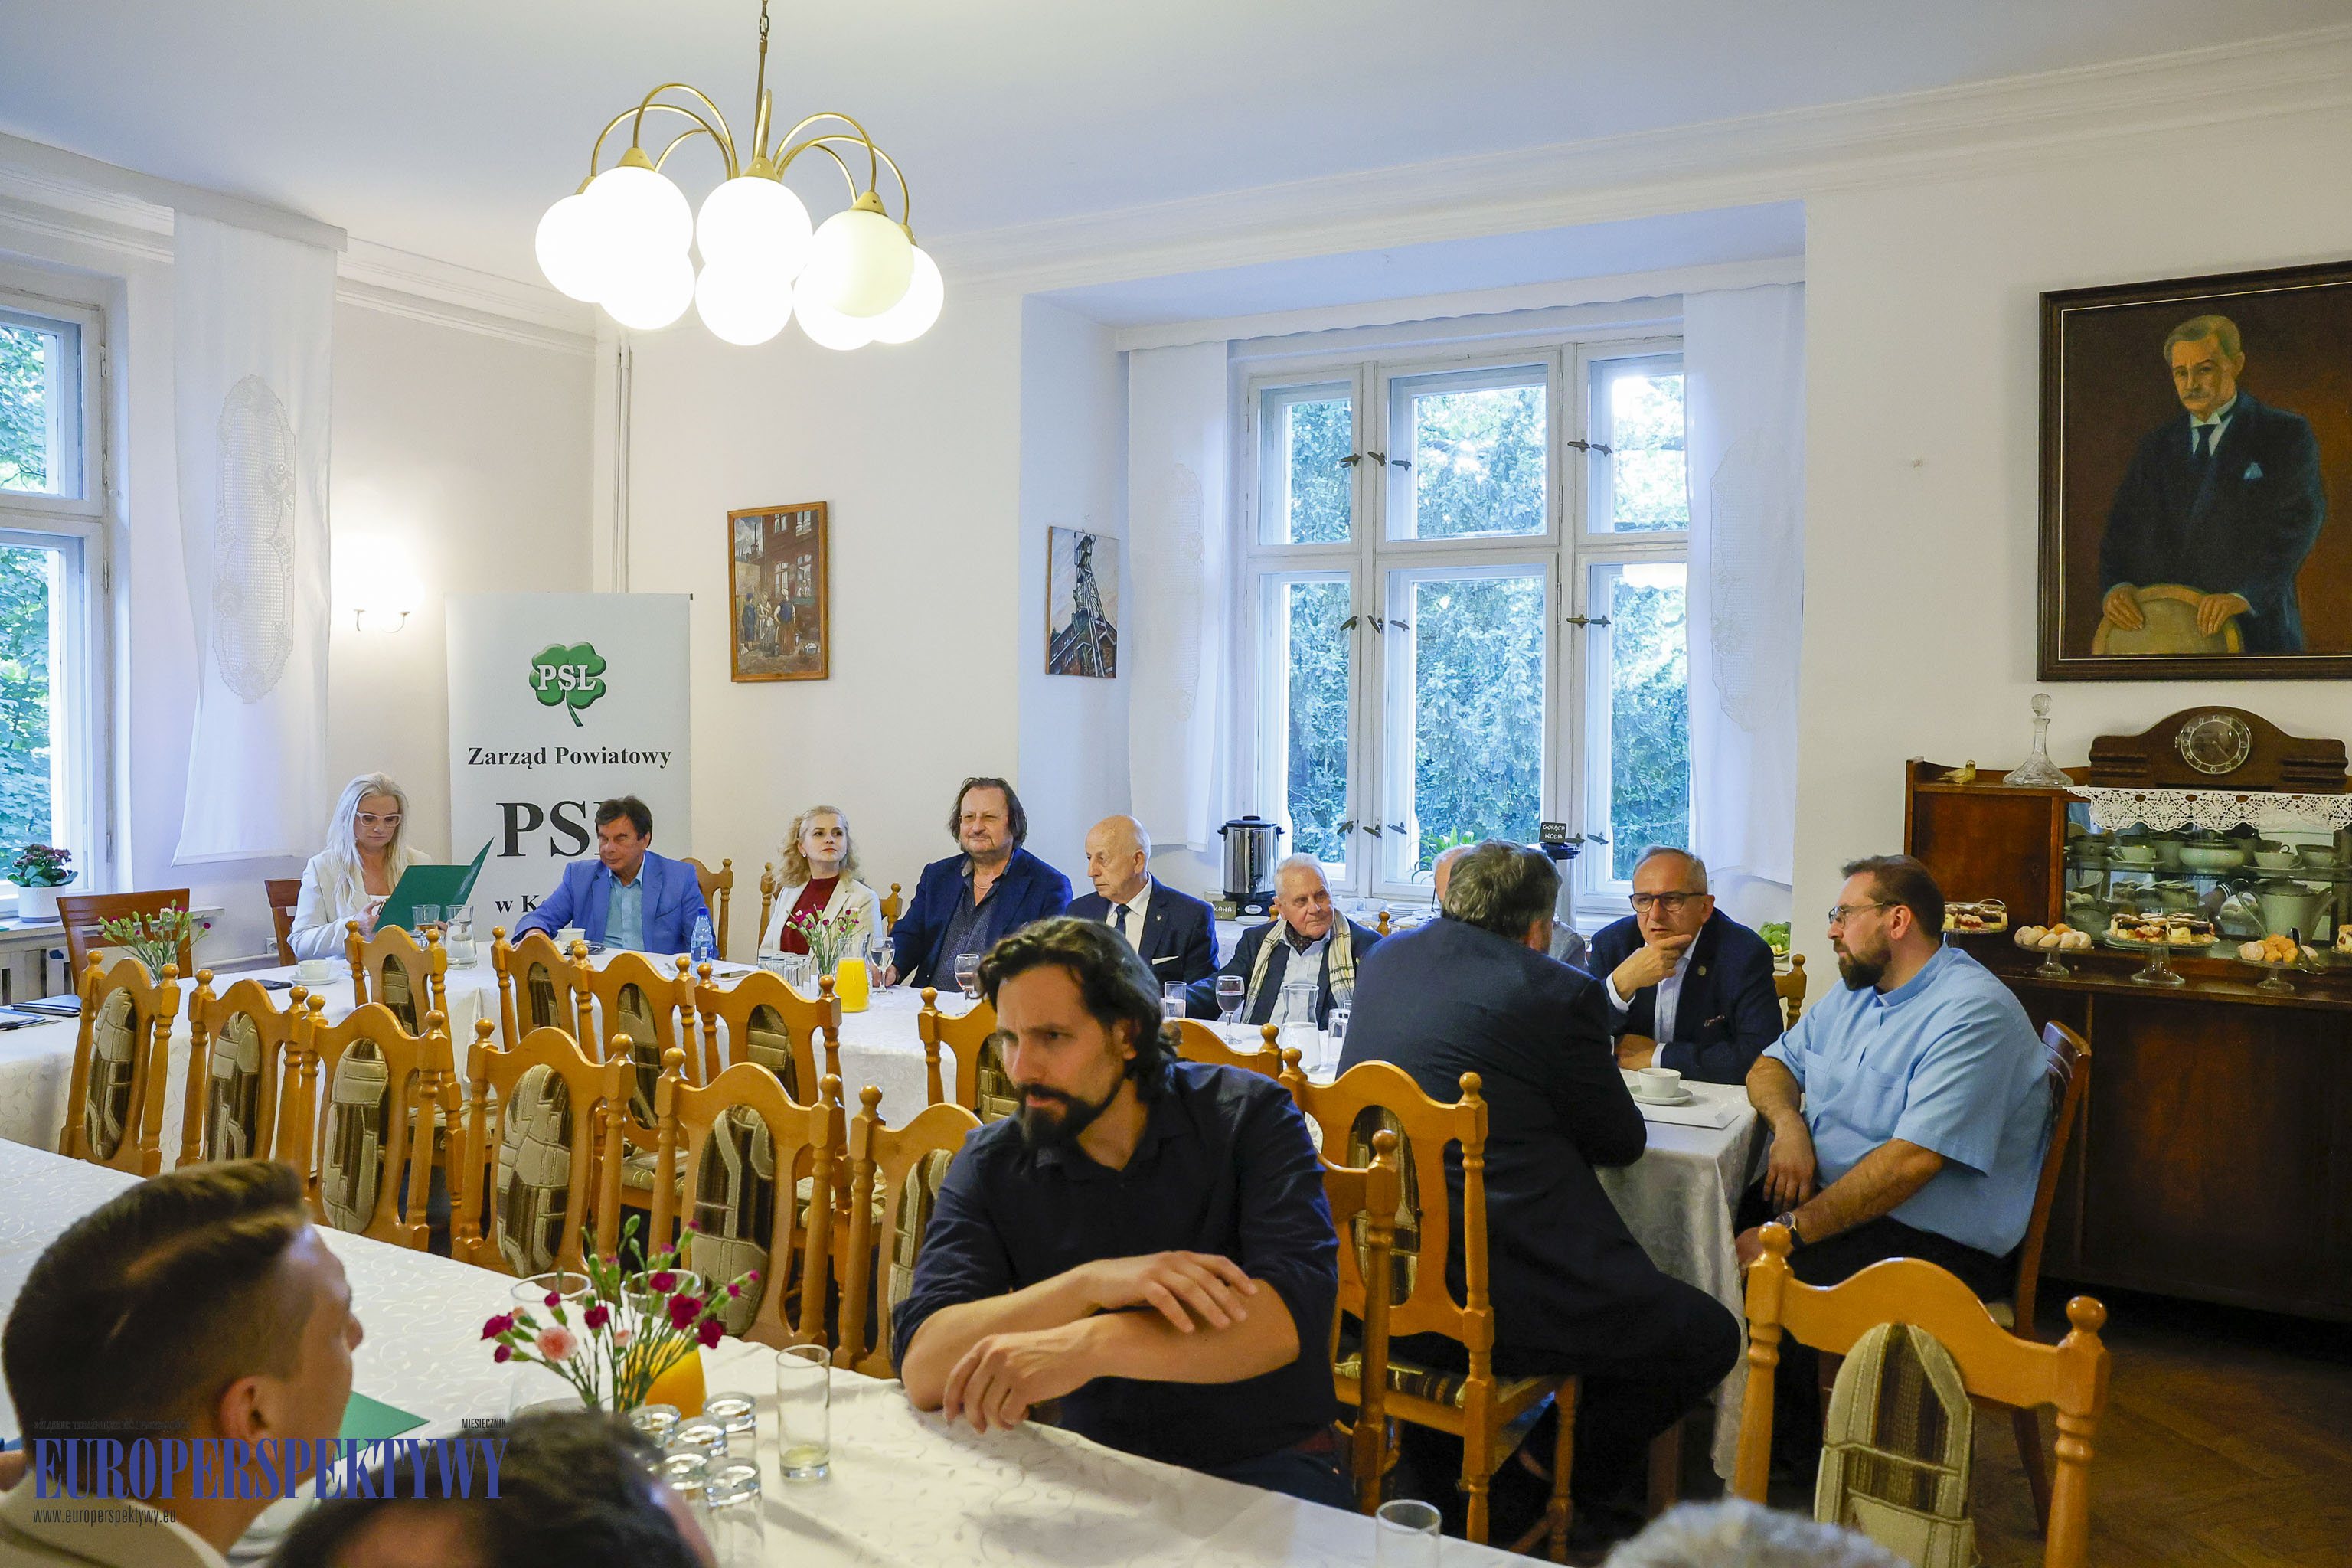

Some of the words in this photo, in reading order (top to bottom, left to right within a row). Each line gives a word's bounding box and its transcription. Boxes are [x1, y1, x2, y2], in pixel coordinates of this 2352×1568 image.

[537, 664, 596, 691] PSL
[468, 747, 547, 769] Zarząd
[554, 746, 672, 769] Powiatowy
[496, 801, 604, 857] PS
[495, 900, 514, 913] w
